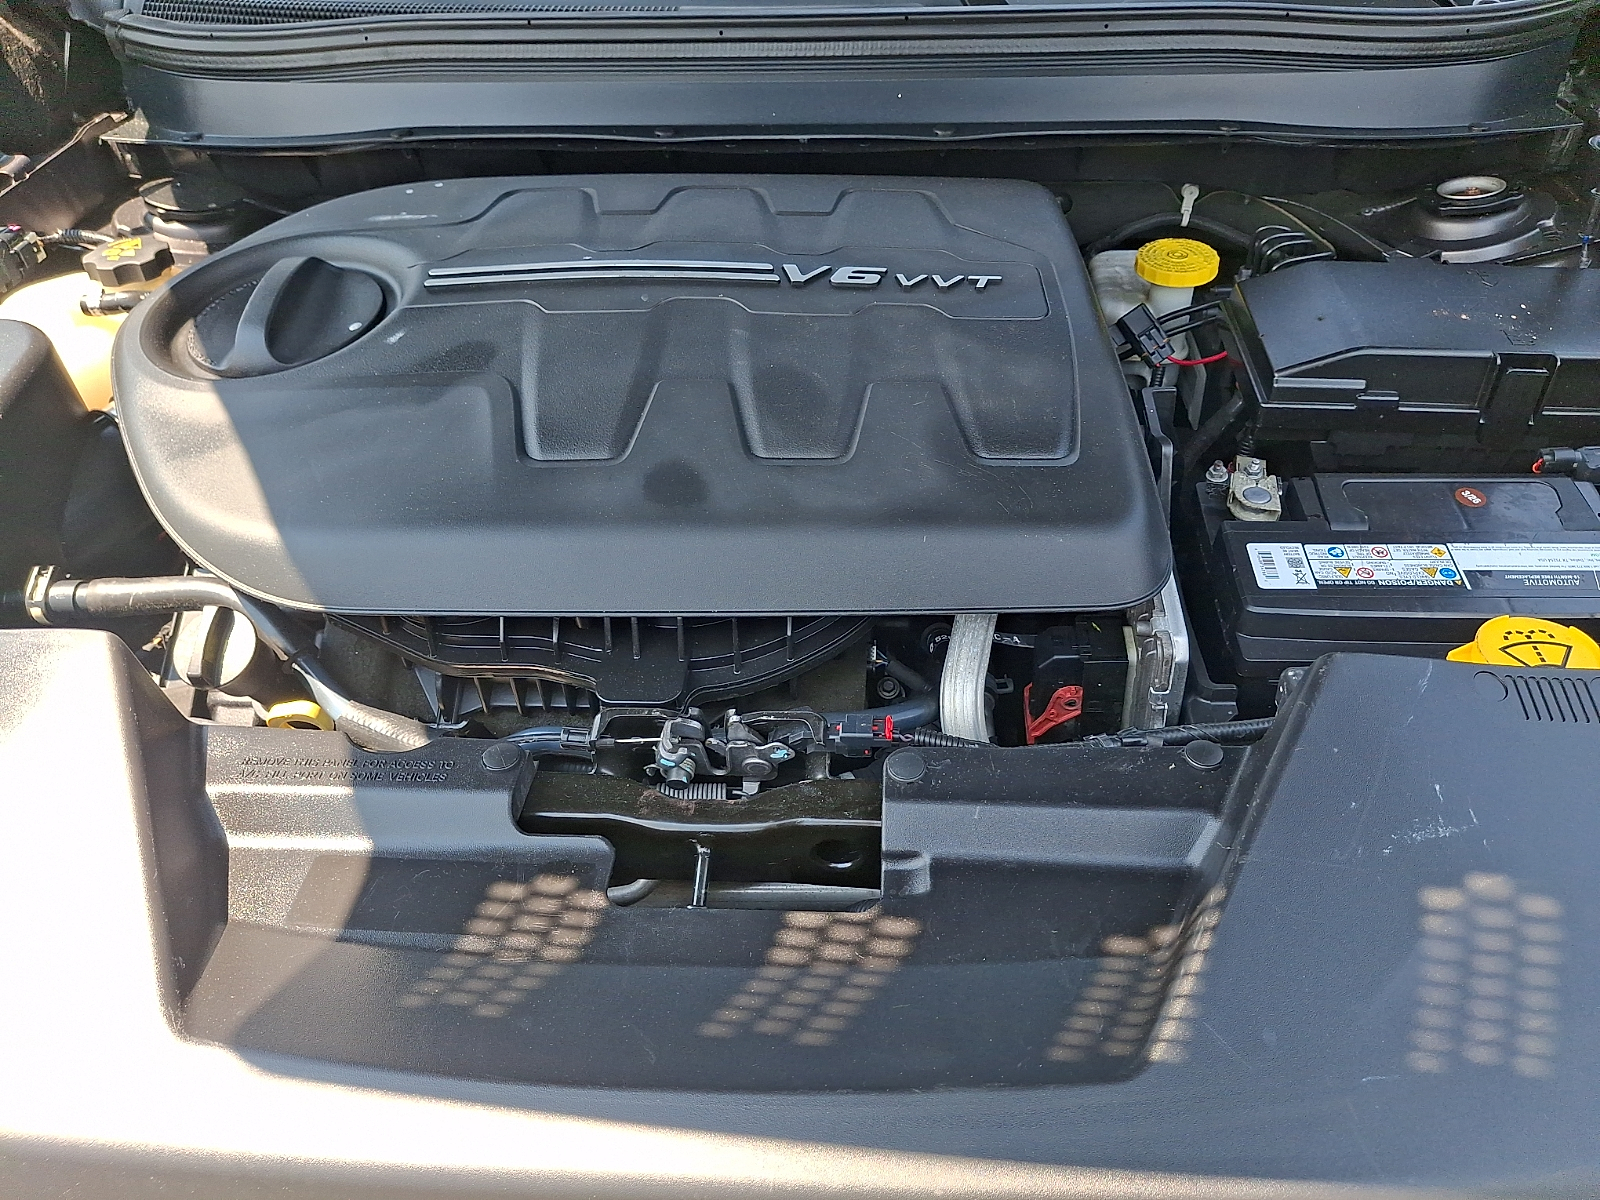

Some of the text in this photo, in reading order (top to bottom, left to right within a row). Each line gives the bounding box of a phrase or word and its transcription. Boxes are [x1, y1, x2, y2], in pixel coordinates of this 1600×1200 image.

[781, 263, 1004, 290] V6 VVT
[1377, 579, 1454, 587] DANGER/POISON
[293, 757, 320, 767] THIS
[321, 757, 359, 769] PANEL
[361, 758, 386, 769] FOR
[388, 759, 436, 770] ACCESS
[438, 760, 456, 770] TO
[328, 770, 350, 780] ON
[349, 771, 385, 781] SOME
[388, 772, 448, 782] VEHICLES
